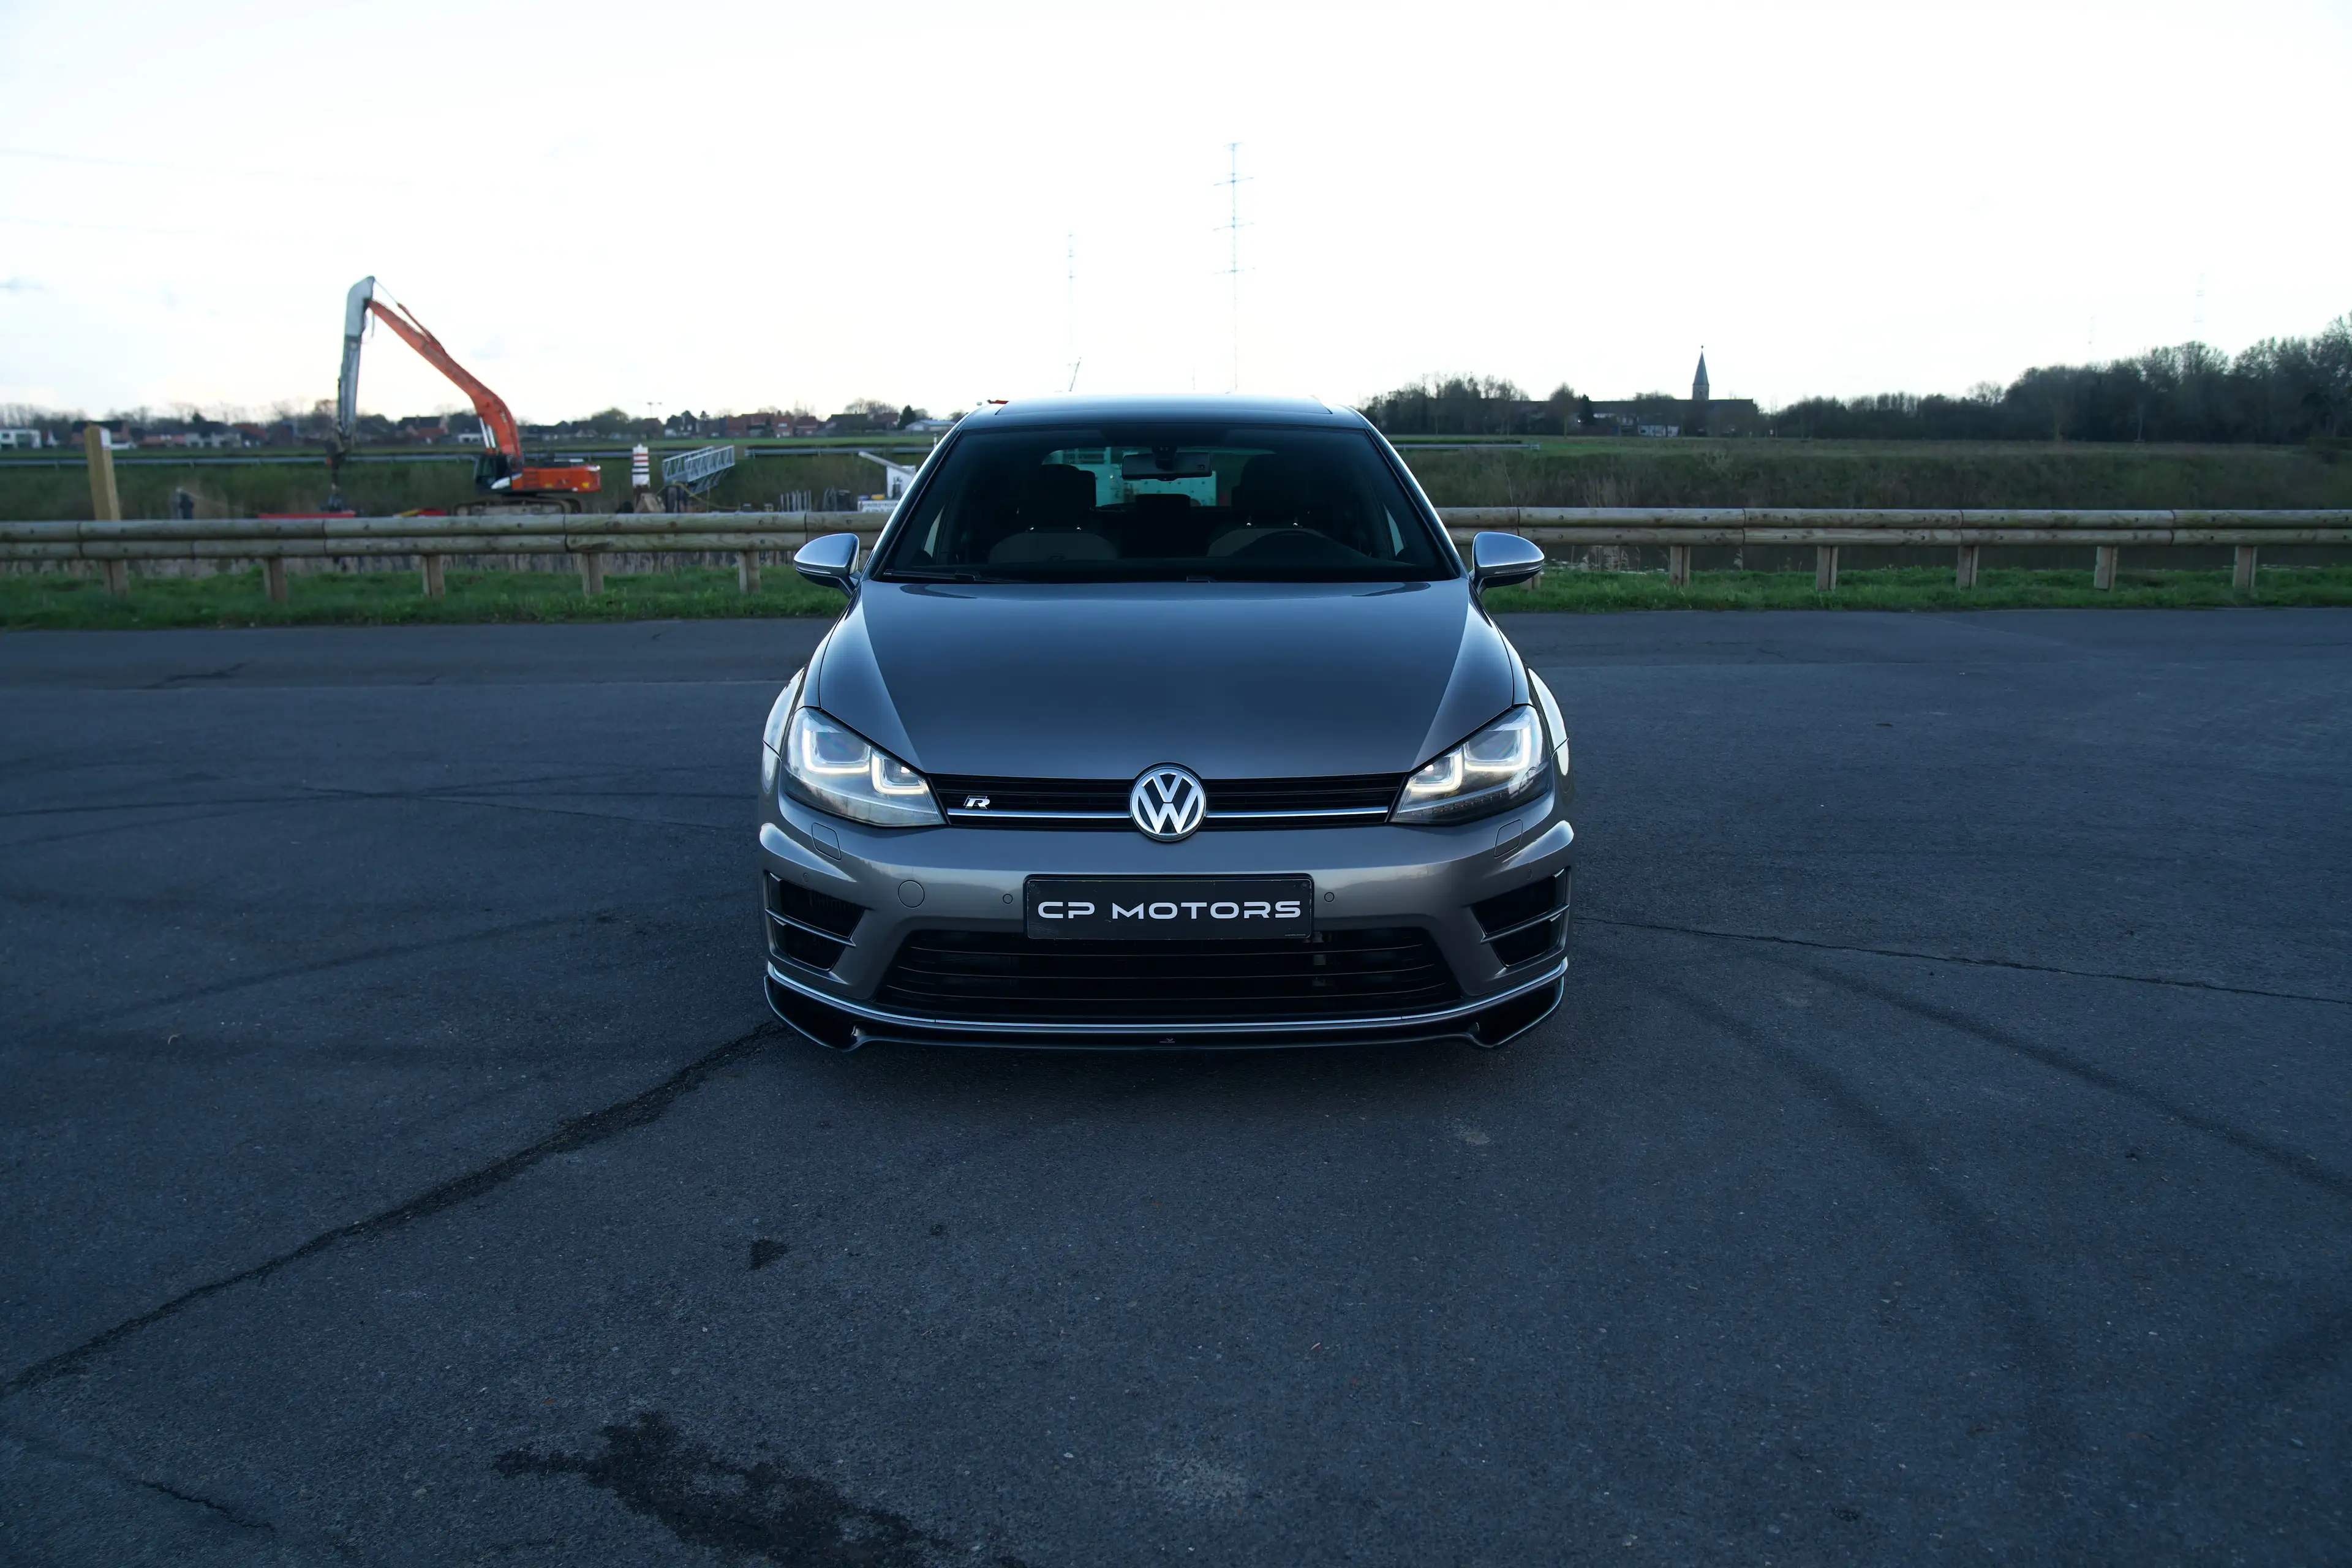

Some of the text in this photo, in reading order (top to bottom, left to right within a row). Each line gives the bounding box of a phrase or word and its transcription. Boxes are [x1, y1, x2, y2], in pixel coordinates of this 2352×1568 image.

[963, 796, 990, 810] R
[1133, 769, 1204, 839] VW
[1038, 900, 1302, 919] CP MOTORS
